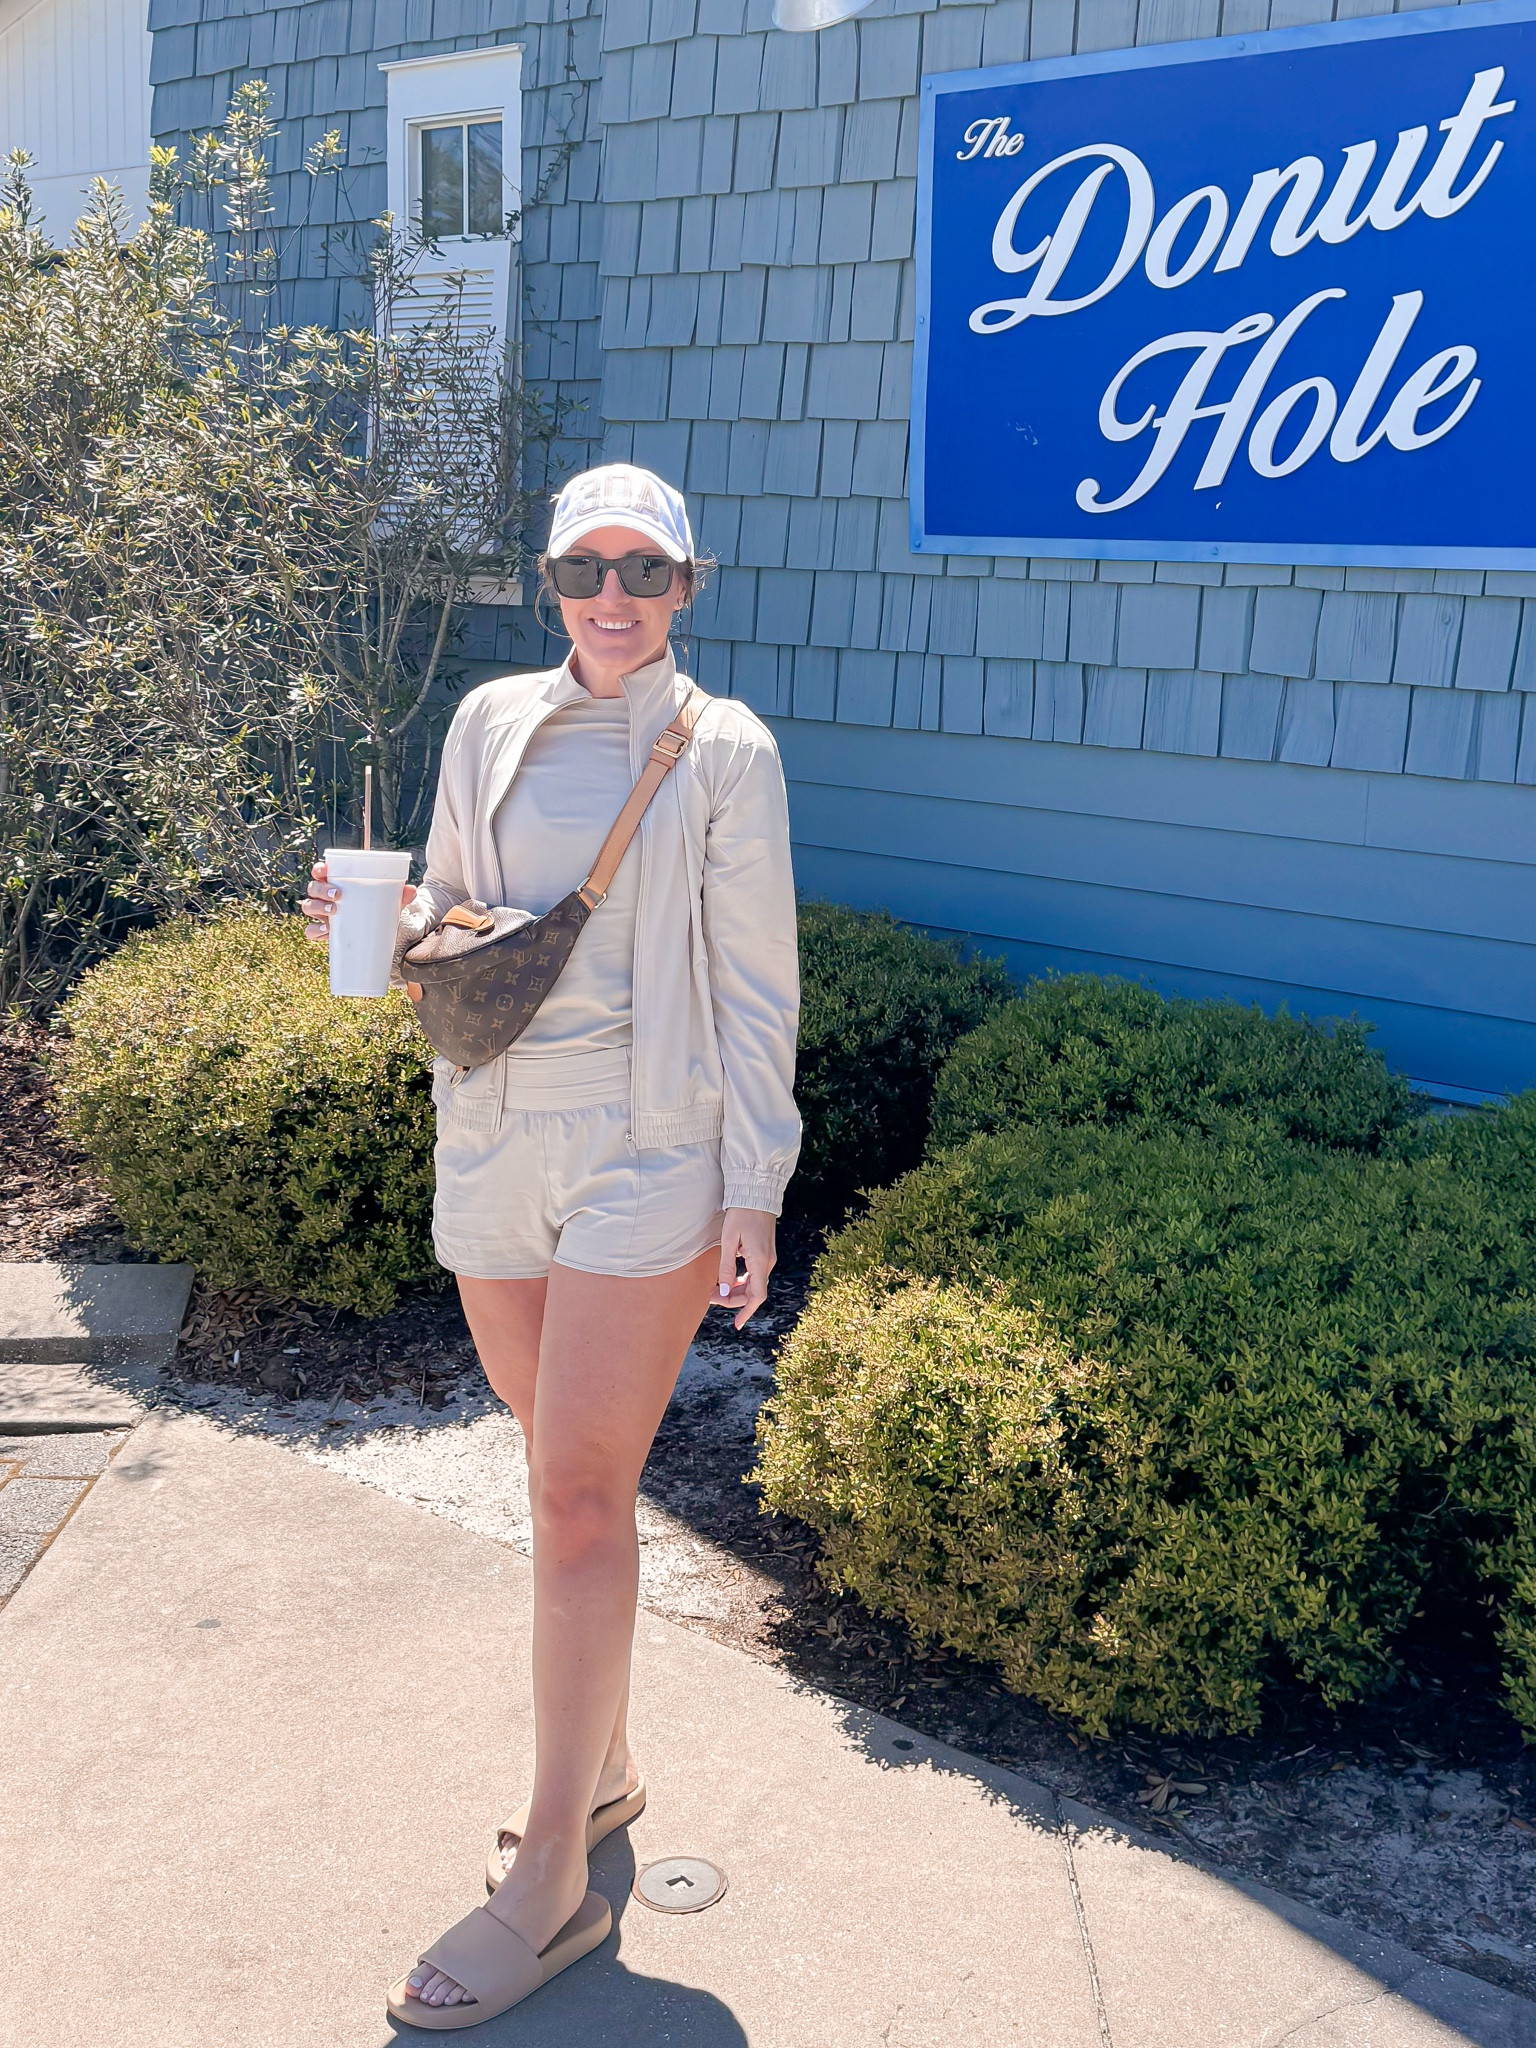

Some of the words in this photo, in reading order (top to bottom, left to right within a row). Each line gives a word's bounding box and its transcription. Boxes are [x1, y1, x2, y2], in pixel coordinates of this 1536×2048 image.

[956, 116, 1024, 161] The
[969, 66, 1516, 334] Donut
[1076, 288, 1482, 513] Hole
